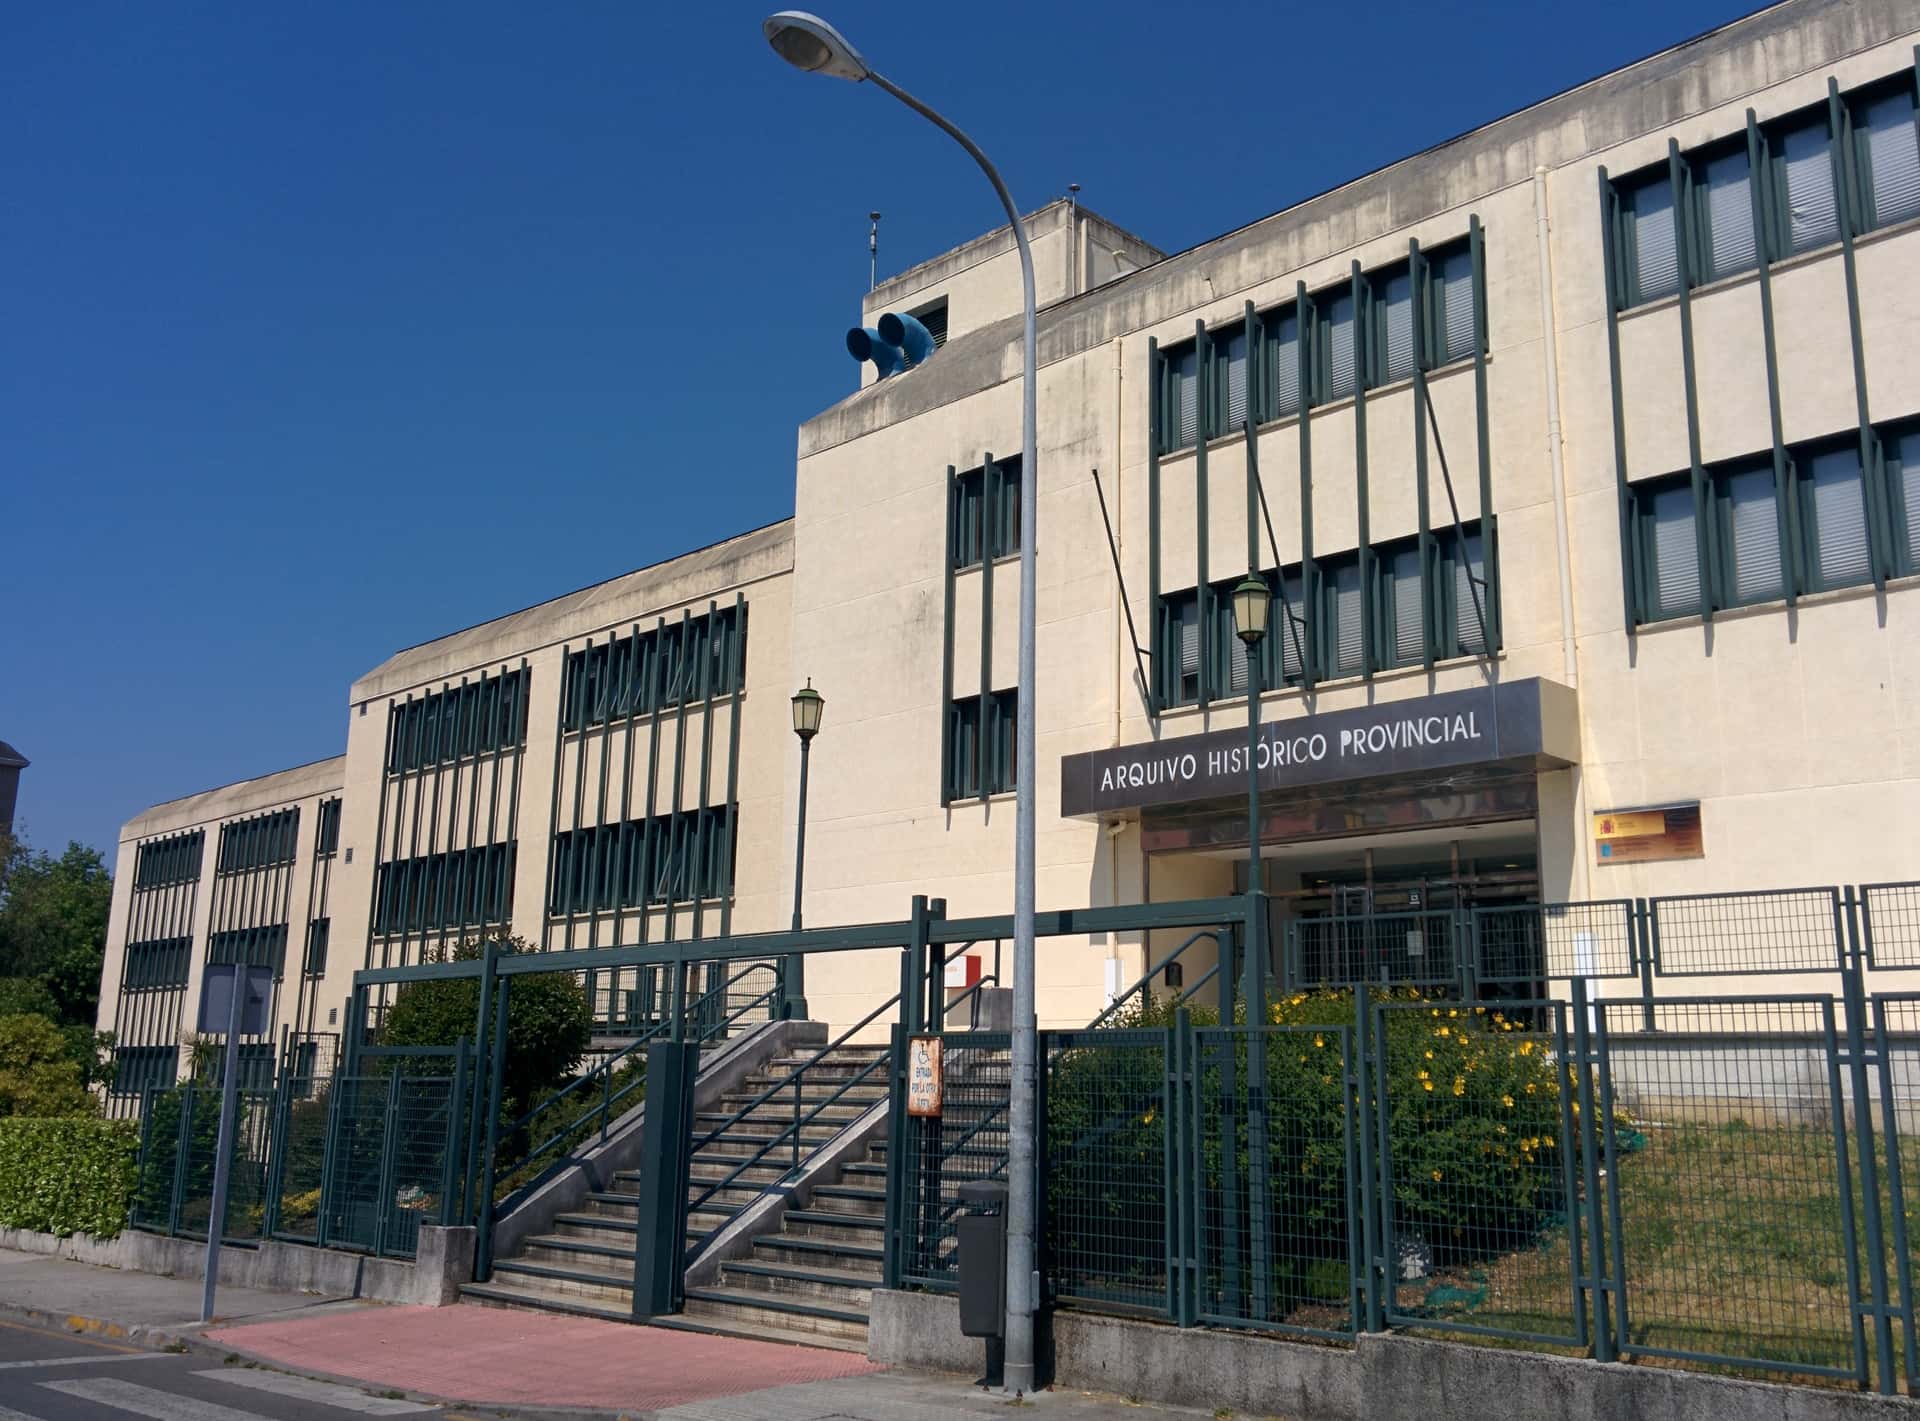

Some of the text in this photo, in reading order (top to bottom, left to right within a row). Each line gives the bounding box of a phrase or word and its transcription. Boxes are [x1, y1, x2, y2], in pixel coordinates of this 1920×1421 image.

[1101, 711, 1481, 792] ARQUIVO HISTÓRICO PROVINCIAL
